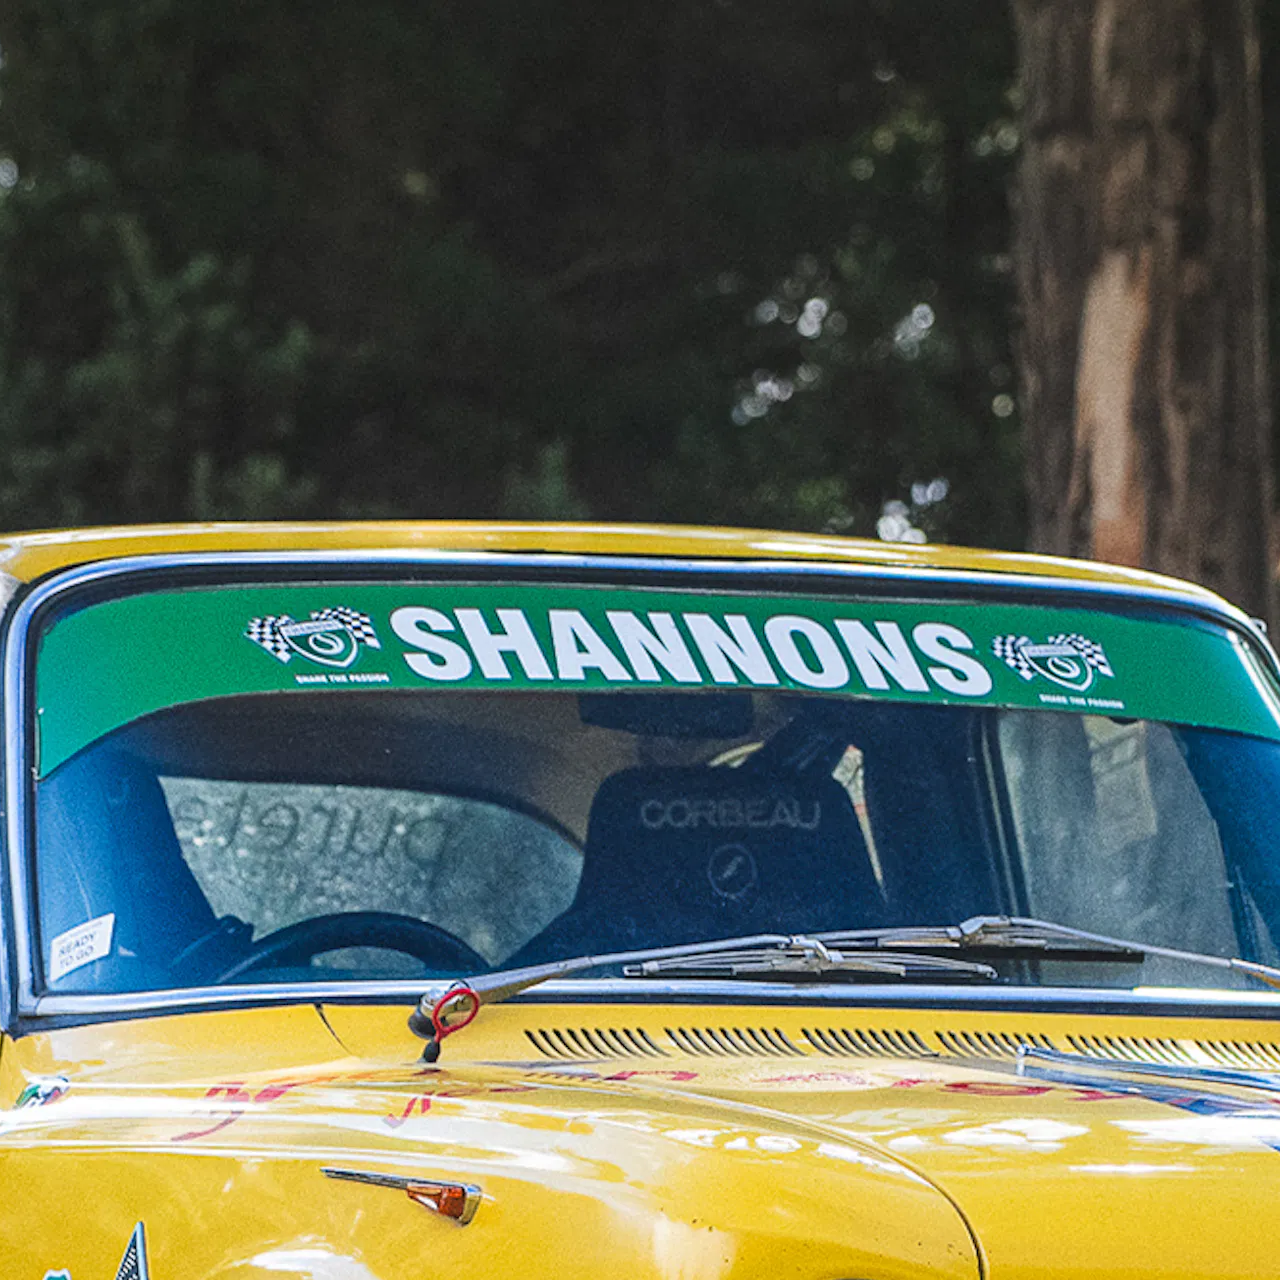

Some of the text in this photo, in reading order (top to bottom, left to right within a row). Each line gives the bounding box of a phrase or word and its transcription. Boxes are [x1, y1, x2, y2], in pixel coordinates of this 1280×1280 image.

[388, 604, 994, 698] SHANNONS
[329, 673, 348, 683] THE
[639, 798, 822, 830] CORBEAU
[58, 930, 98, 957] READY
